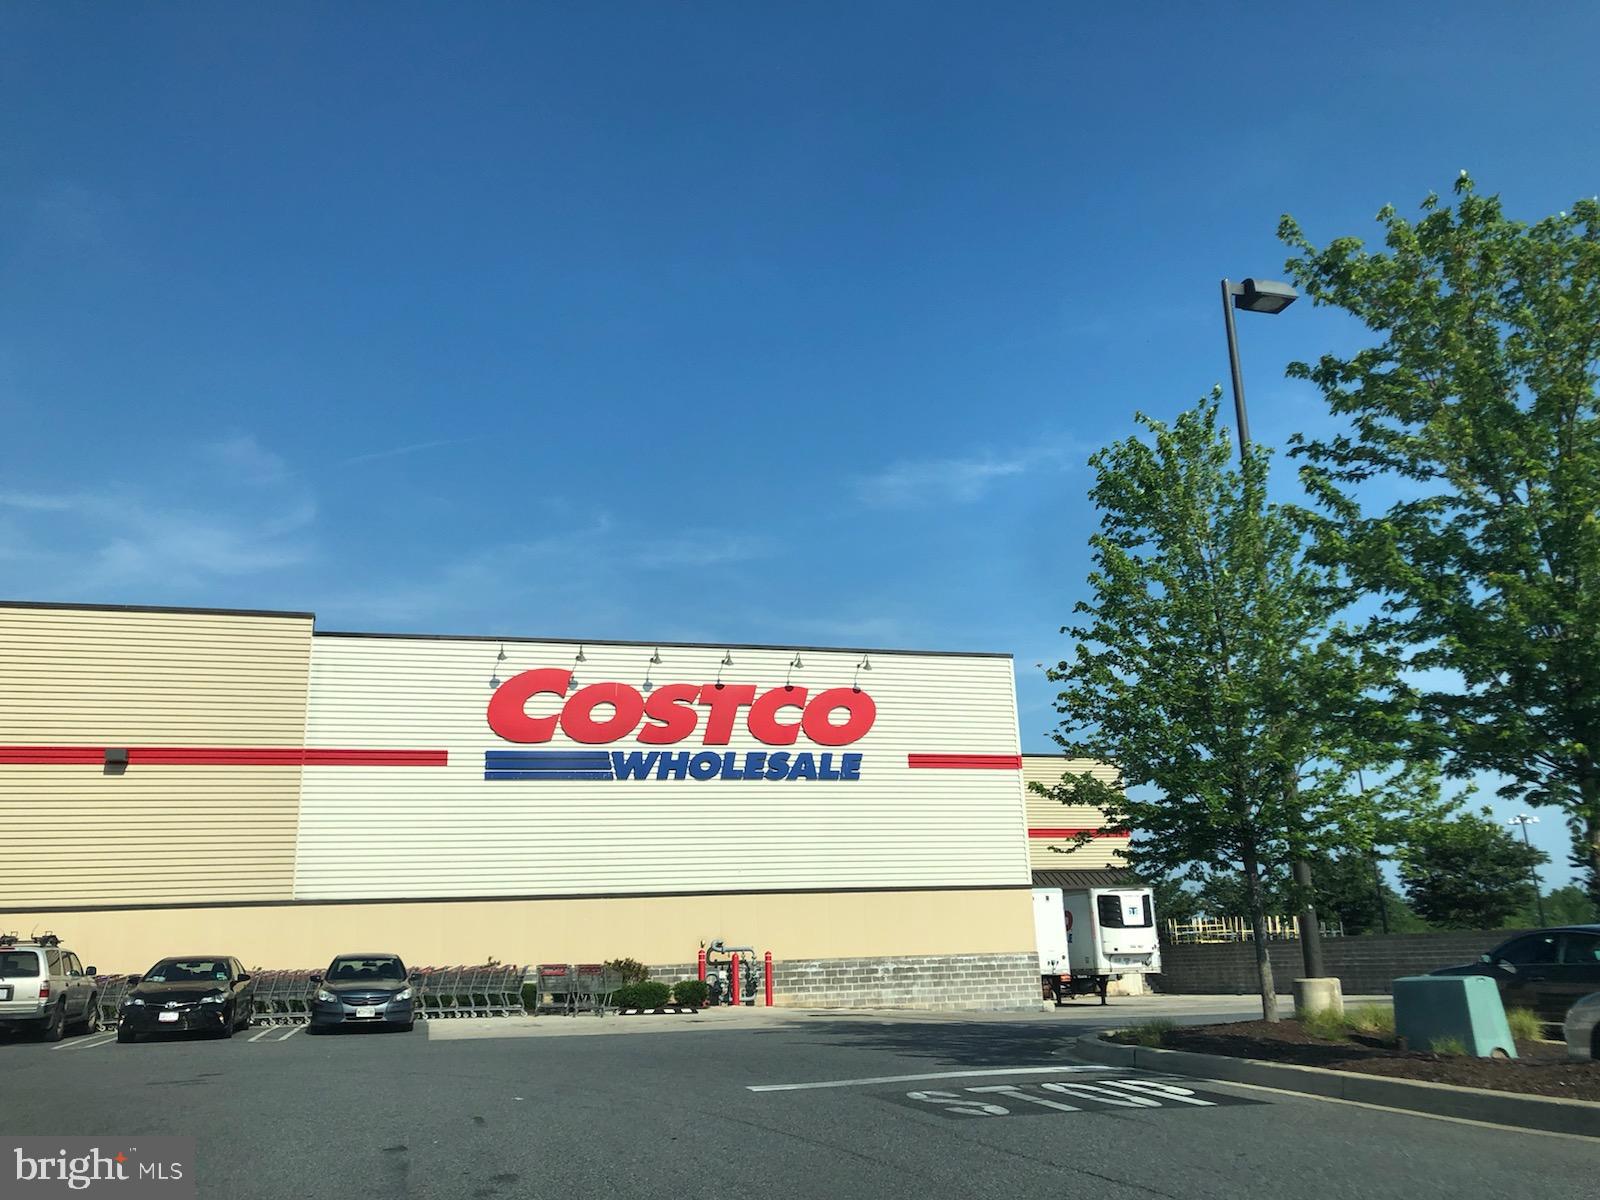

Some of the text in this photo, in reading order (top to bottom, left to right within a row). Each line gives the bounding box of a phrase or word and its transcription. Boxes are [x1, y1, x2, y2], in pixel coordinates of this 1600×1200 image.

[487, 668, 876, 746] COSTCO
[609, 751, 863, 781] WHOLESALE
[906, 1079, 1217, 1115] STOP
